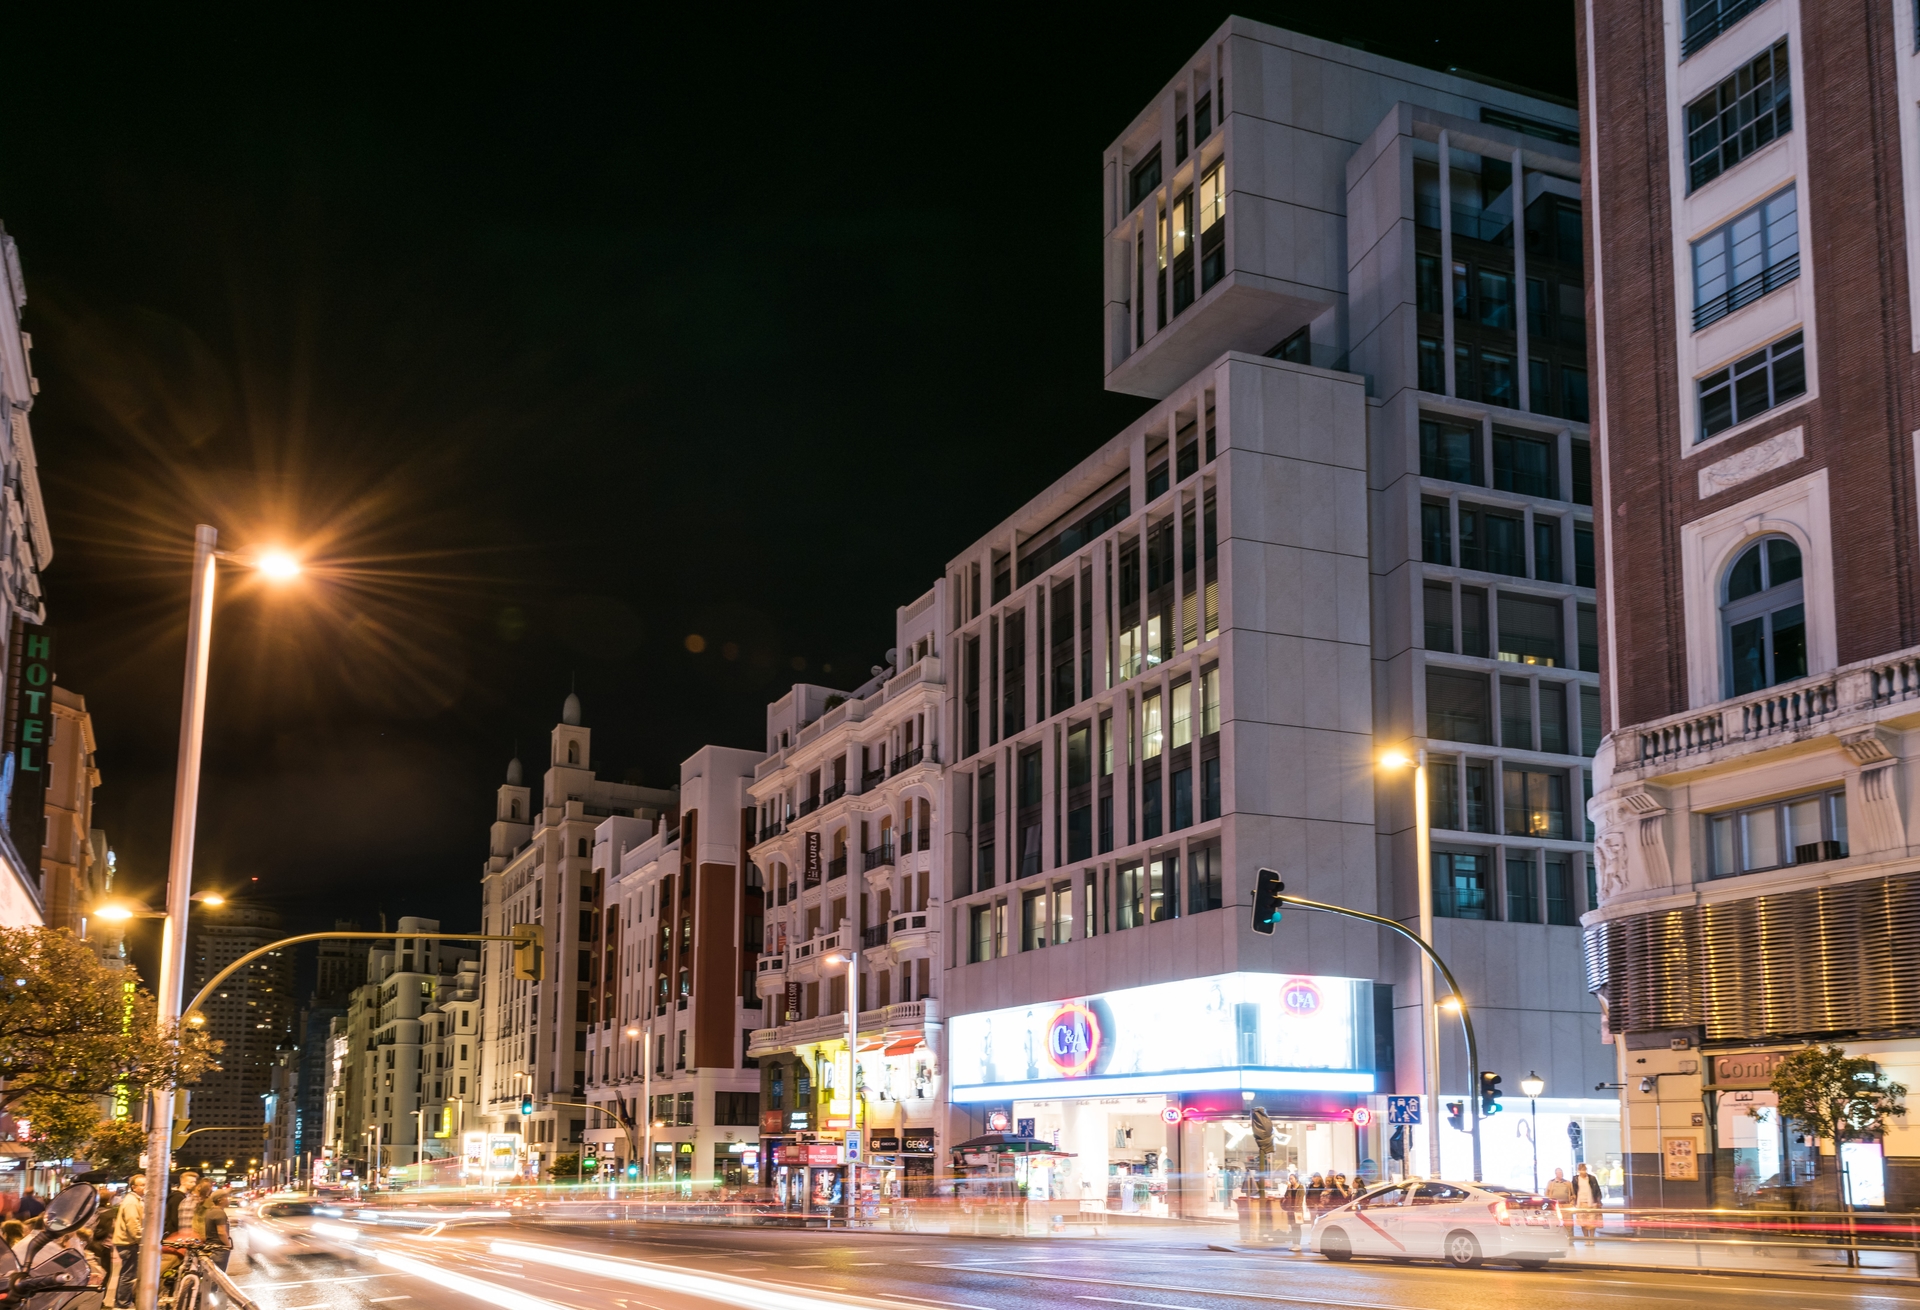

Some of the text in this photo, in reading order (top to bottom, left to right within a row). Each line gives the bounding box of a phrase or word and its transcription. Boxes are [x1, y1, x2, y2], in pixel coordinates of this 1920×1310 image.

[21, 634, 50, 772] HOTEL
[788, 983, 797, 1012] EXCELSIOR
[1053, 1022, 1089, 1055] C&A
[906, 1140, 929, 1149] GEOX
